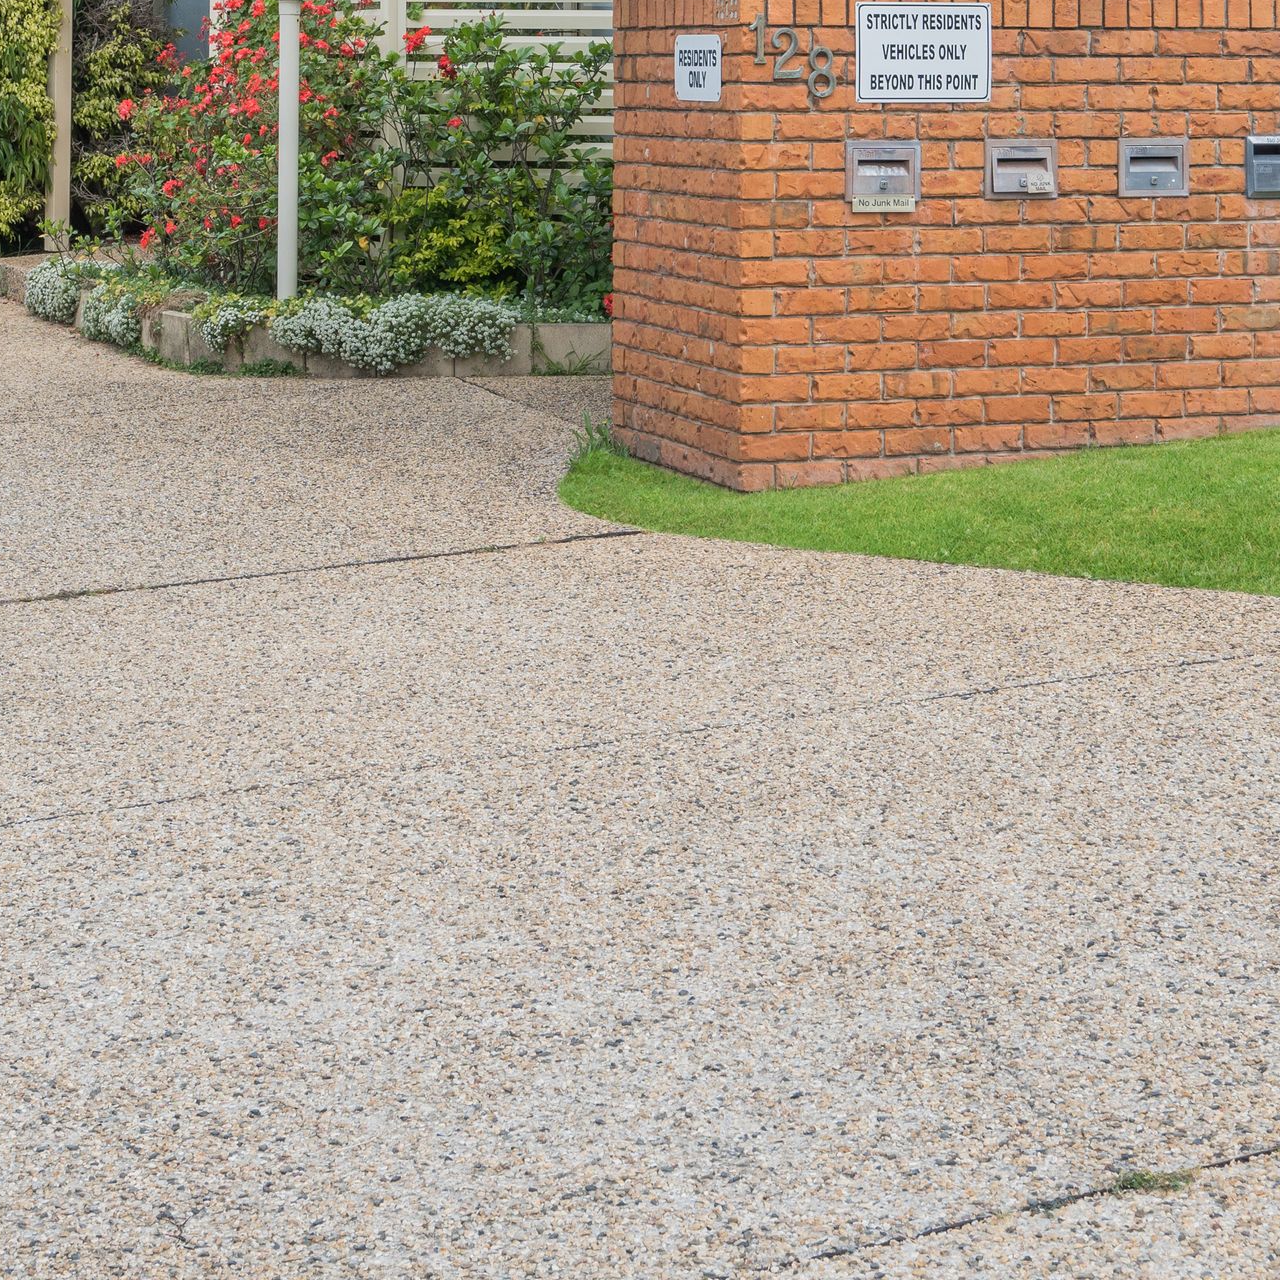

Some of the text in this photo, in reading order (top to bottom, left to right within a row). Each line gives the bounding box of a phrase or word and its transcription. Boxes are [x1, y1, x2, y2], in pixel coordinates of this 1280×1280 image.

[866, 13, 982, 31] STRICTLY RESIDENTS
[678, 49, 717, 67] RESIDENTS
[749, 12, 837, 98] 128
[882, 44, 967, 60] VEHICLES ONLY
[688, 70, 707, 89] ONLY
[870, 74, 979, 90] BEYOND THIS POINT
[858, 198, 910, 207] No Junk Mail
